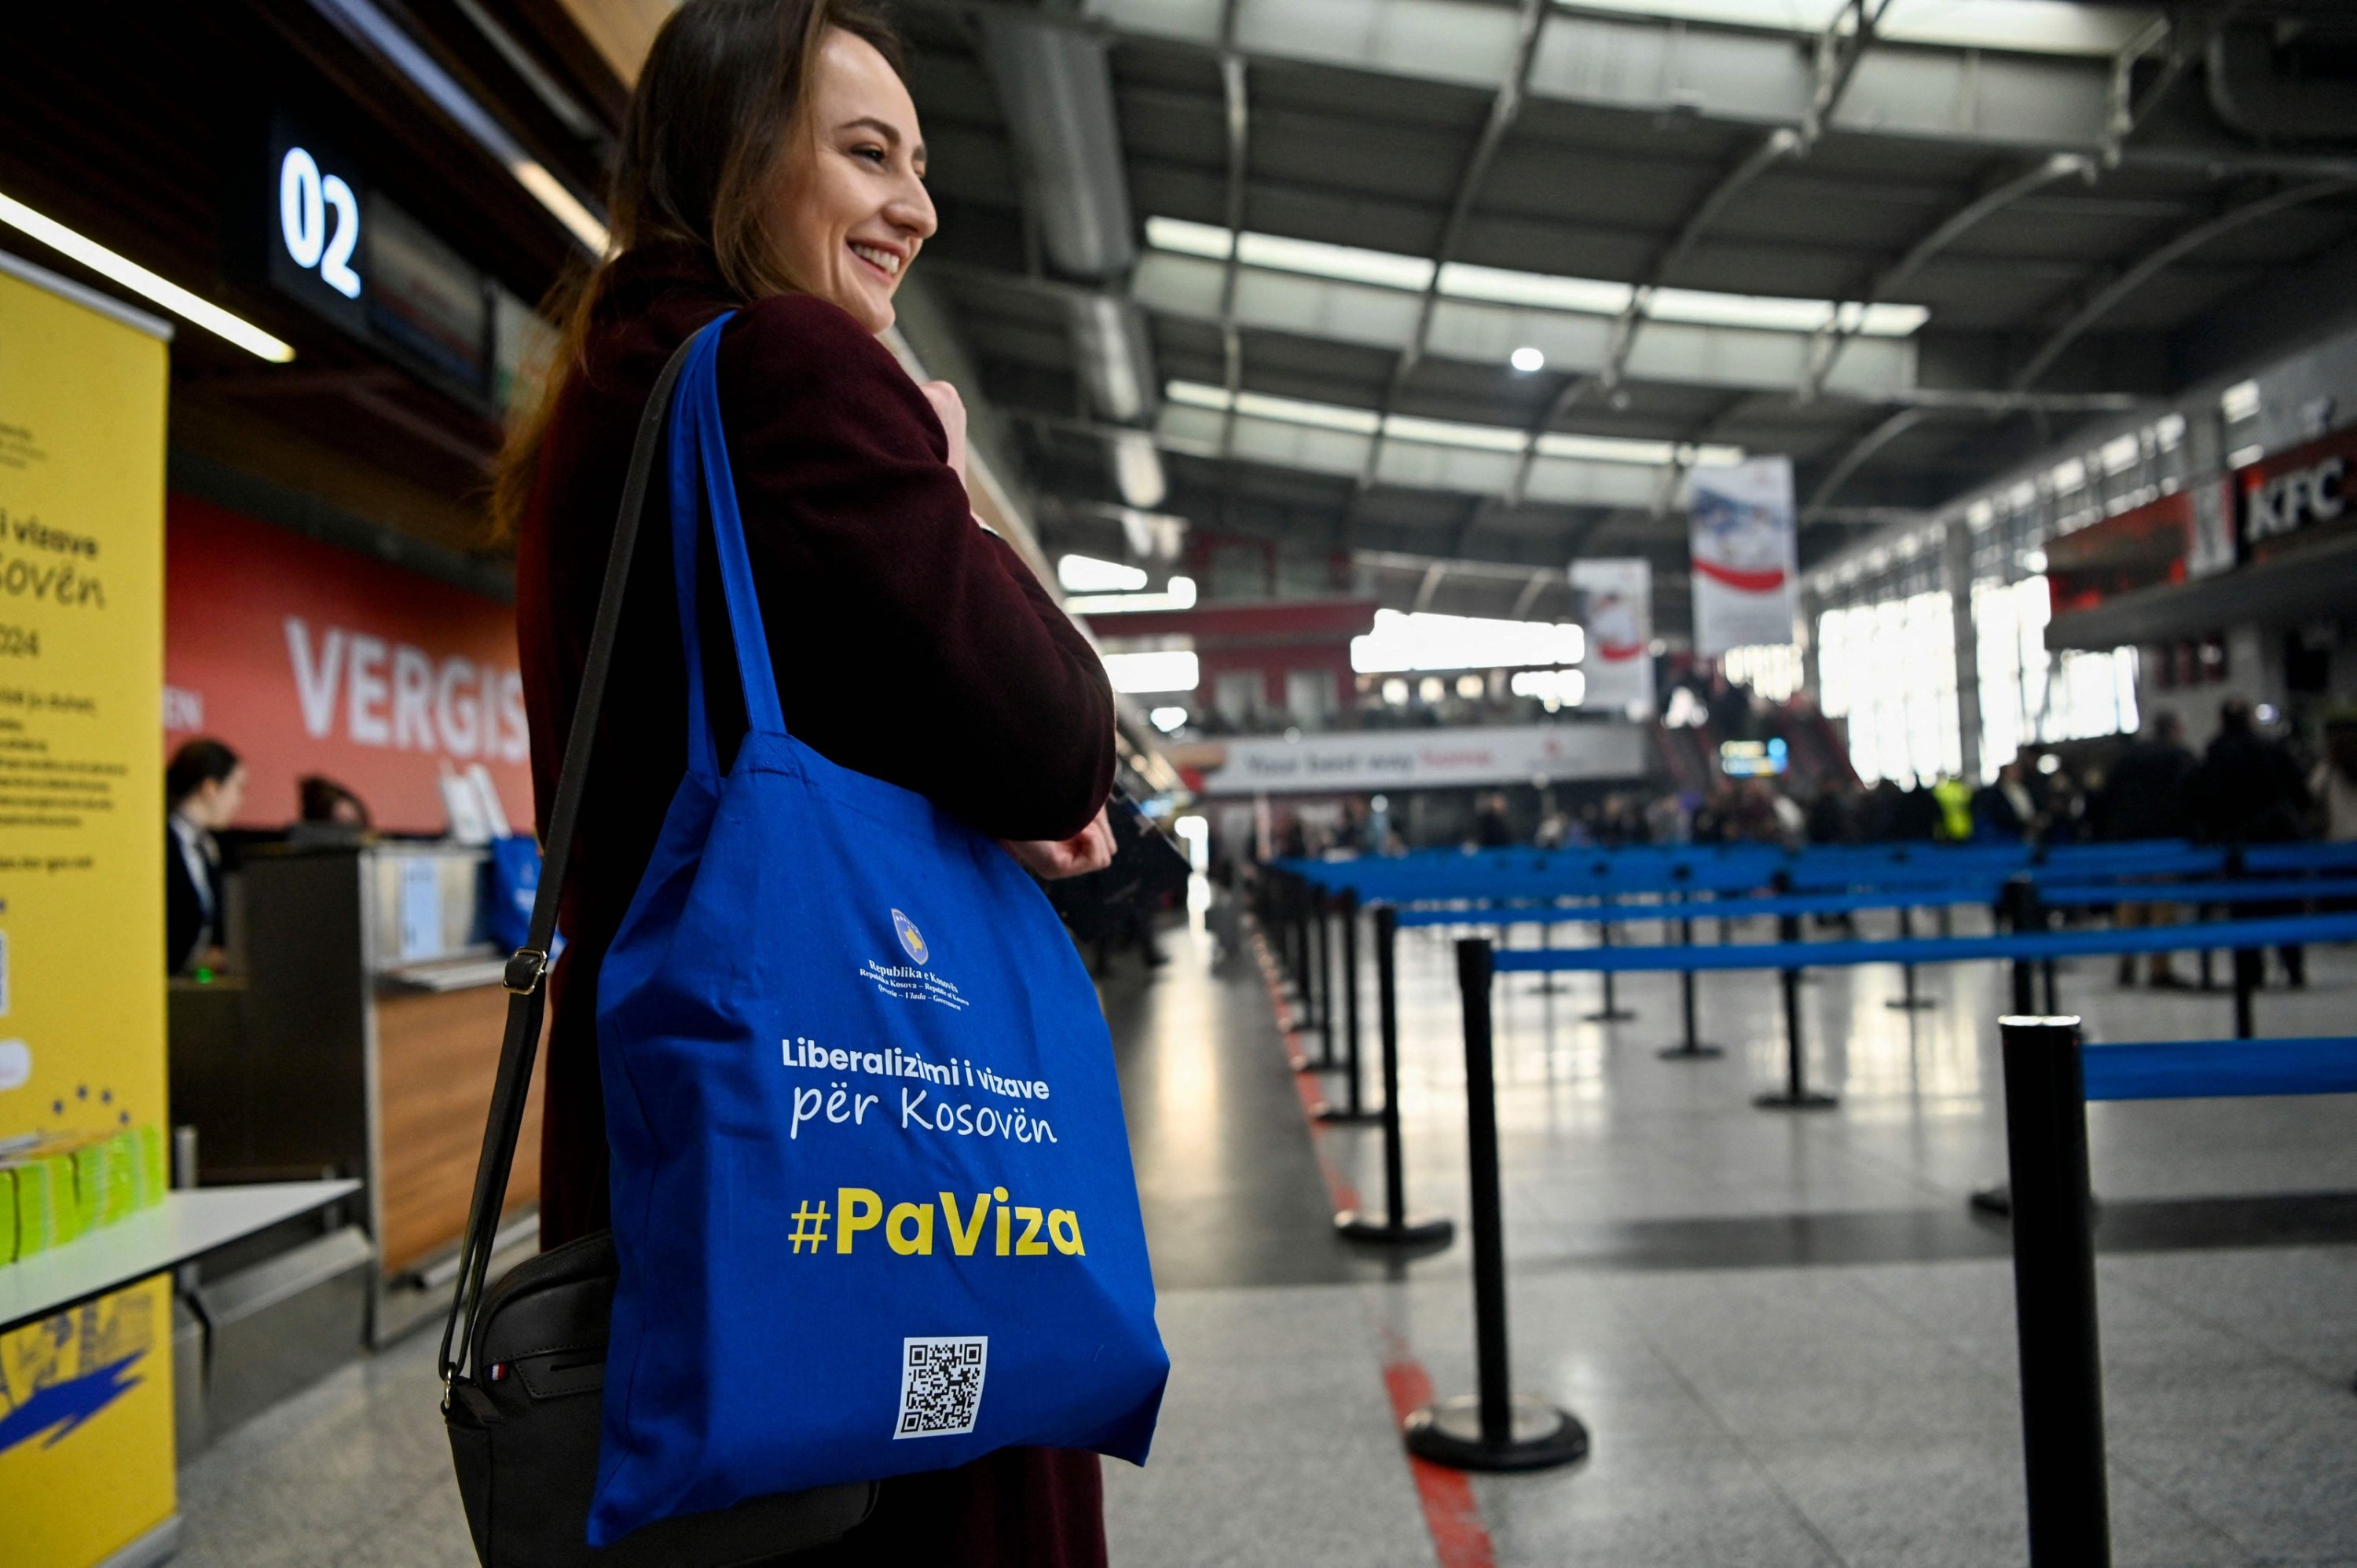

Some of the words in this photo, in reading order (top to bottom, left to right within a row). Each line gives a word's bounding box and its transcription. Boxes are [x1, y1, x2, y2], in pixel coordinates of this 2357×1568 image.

[280, 147, 361, 299] 02
[2245, 456, 2343, 542] KFC
[0, 559, 105, 610] ovën
[868, 959, 922, 979] Republika
[890, 979, 917, 989] Kosova
[905, 991, 926, 1000] Vlada
[933, 995, 961, 1011] Government
[782, 1036, 960, 1086] Liberalizimi
[963, 1059, 974, 1086] i
[977, 1067, 1050, 1100] vizave
[790, 1082, 878, 1140] për
[900, 1086, 1058, 1144] Kosovën
[787, 1185, 1086, 1257] #PaViza
